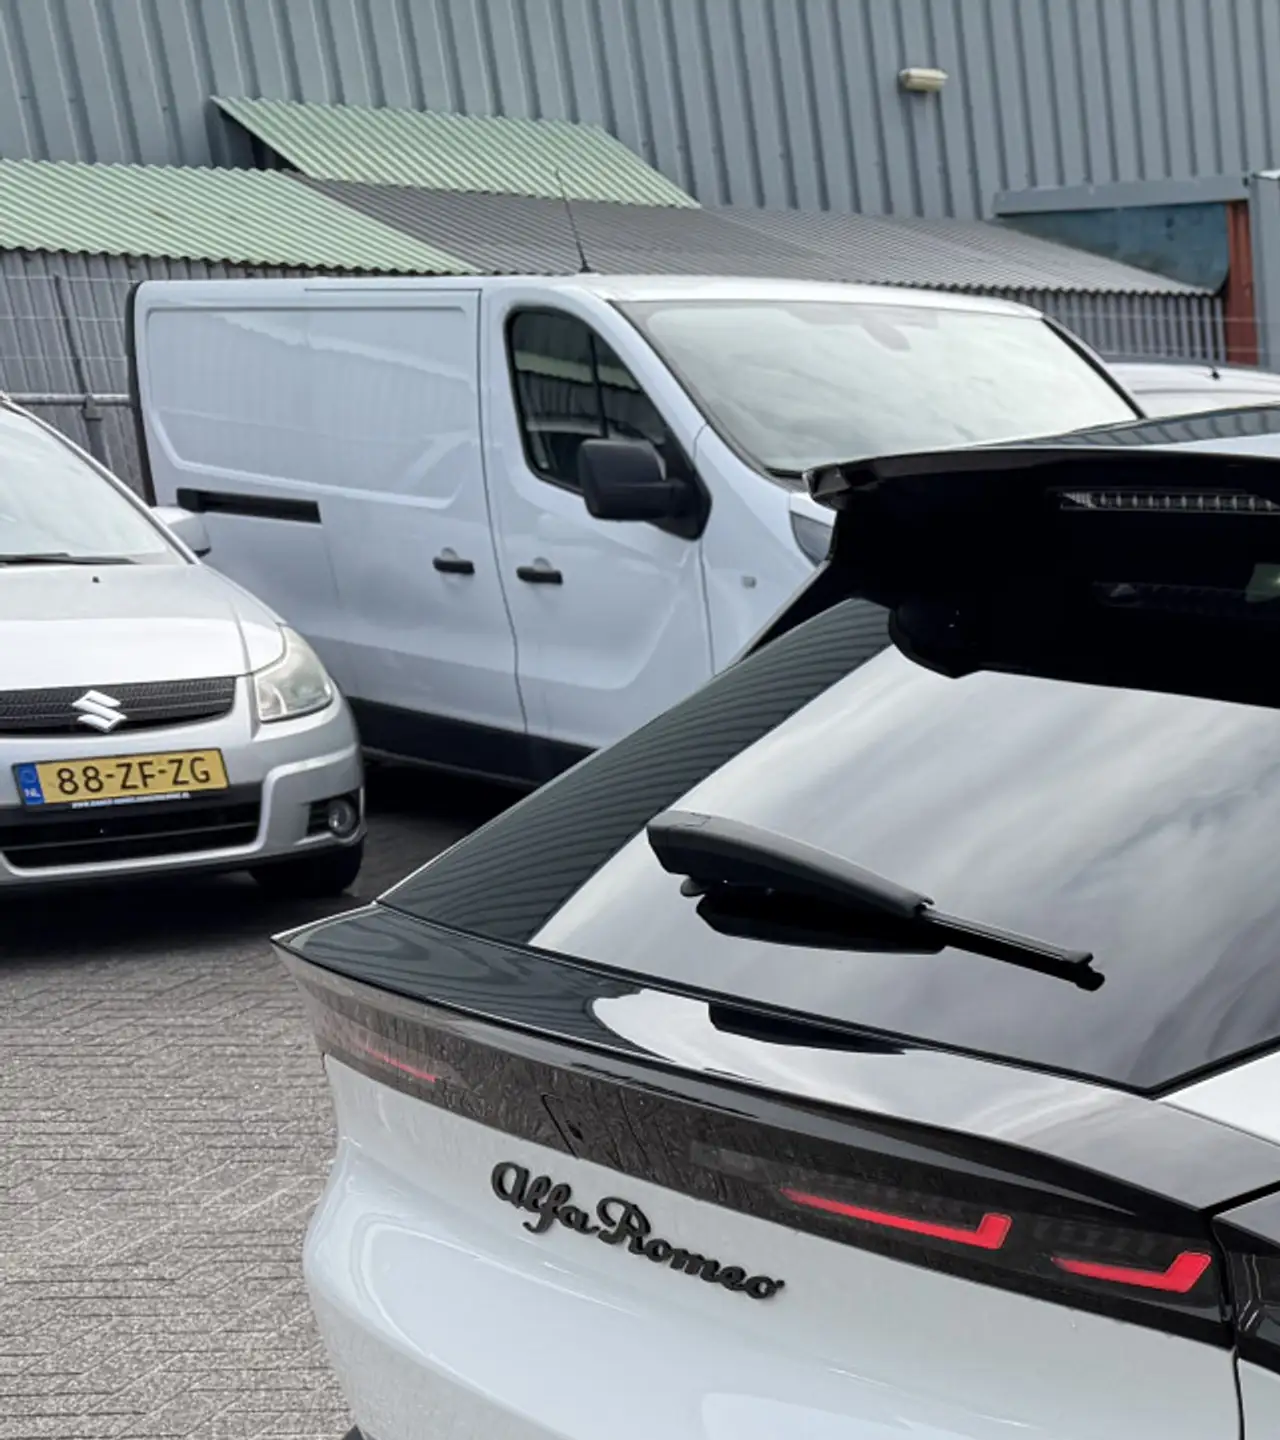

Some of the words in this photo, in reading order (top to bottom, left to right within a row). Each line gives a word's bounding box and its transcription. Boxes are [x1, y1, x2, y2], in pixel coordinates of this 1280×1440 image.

[24, 787, 41, 799] NL
[57, 756, 210, 796] 88-ZF-ZG
[491, 1161, 599, 1234] Alfa
[597, 1196, 786, 1300] Romeo
